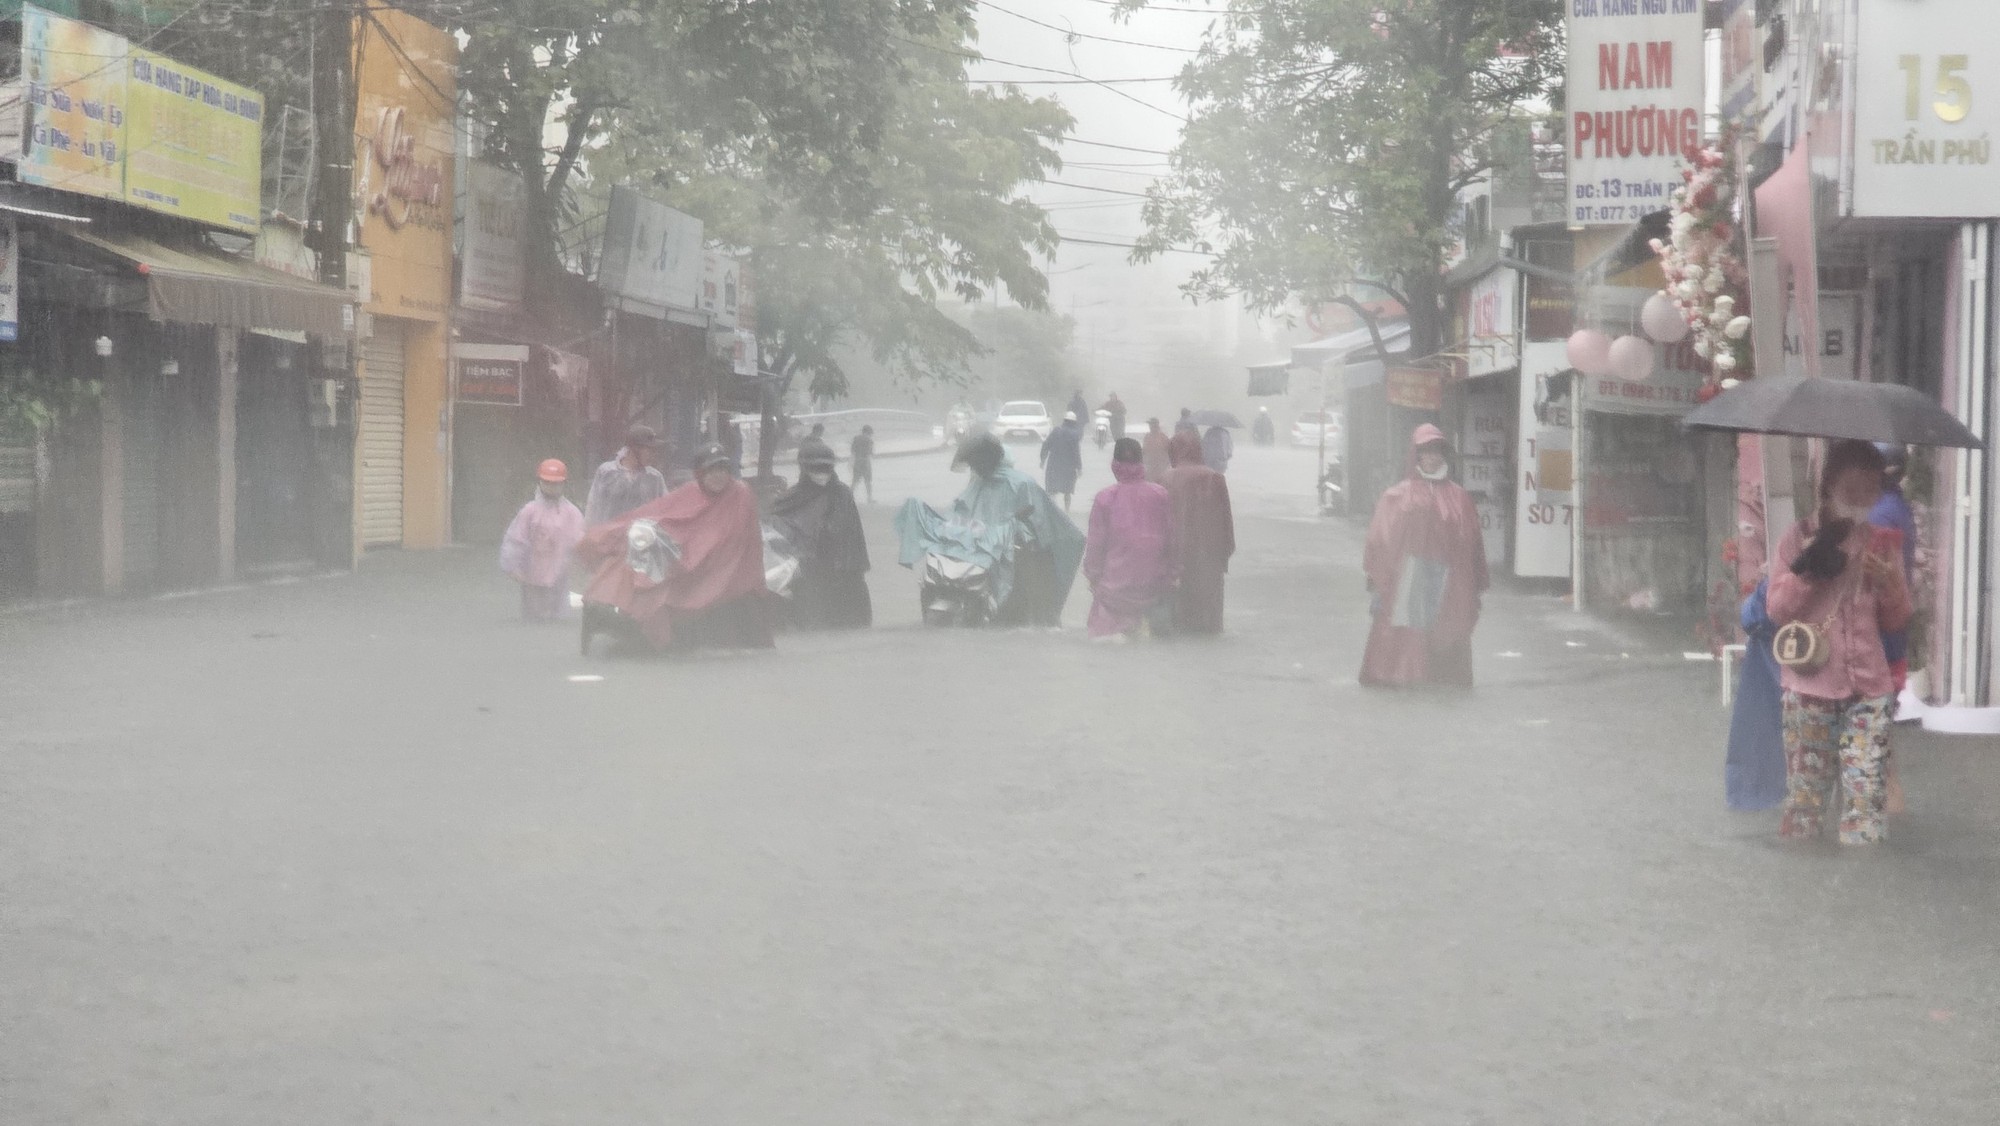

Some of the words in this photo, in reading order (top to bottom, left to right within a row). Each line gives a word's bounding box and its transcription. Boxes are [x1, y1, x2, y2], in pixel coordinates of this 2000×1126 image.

[1599, 41, 1672, 91] NAM
[1899, 54, 1972, 122] 15
[1574, 103, 1698, 160] PHƯƠNG
[1942, 131, 1990, 166] PHÚ
